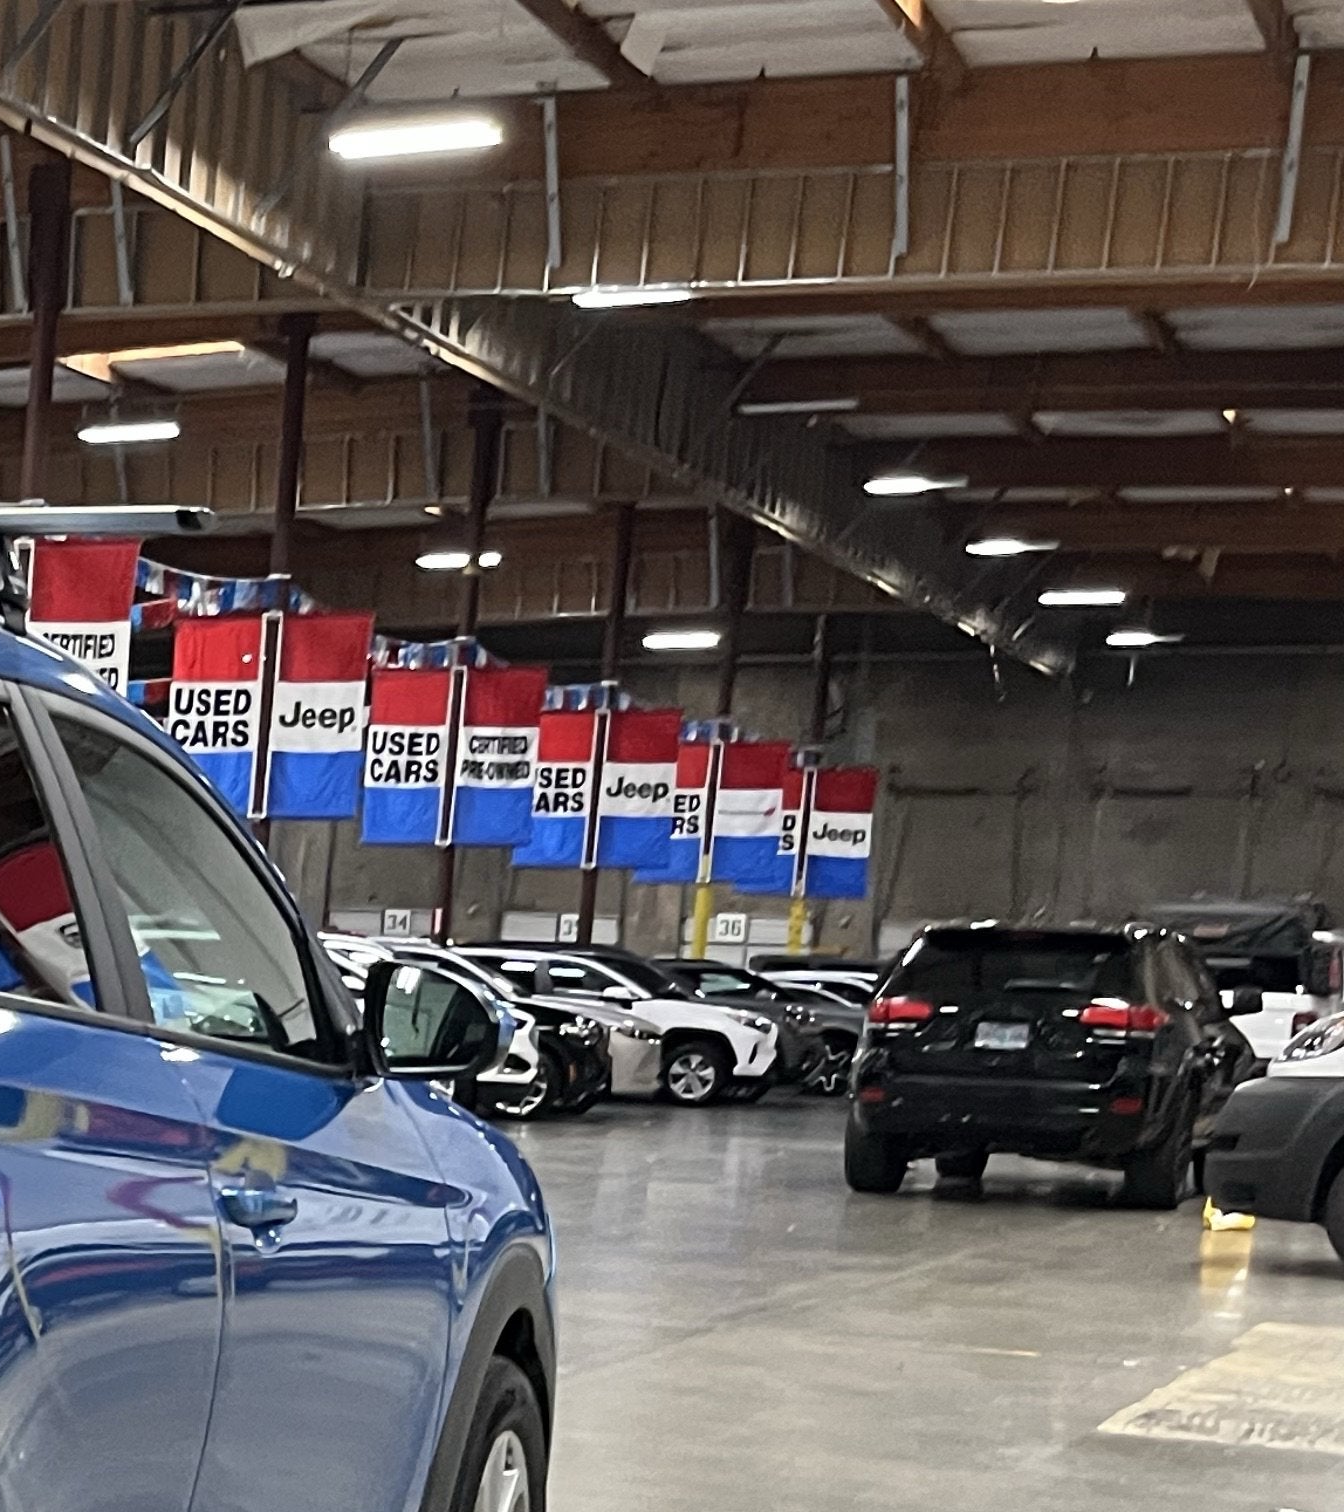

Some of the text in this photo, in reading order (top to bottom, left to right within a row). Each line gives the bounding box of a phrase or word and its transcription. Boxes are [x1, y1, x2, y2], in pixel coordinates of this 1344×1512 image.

[43, 632, 115, 659] RTIFIED
[175, 688, 252, 716] USED
[279, 701, 355, 733] Jeep
[171, 719, 249, 747] CARS
[372, 731, 440, 756] USED
[370, 758, 439, 783] CARS
[535, 767, 586, 789] SED
[606, 776, 669, 803] Jeep
[534, 792, 584, 812] ARS
[673, 794, 701, 814] ED
[672, 815, 699, 835] RS
[813, 823, 866, 846] Jeep
[388, 914, 407, 930] 34
[719, 919, 742, 937] 36
